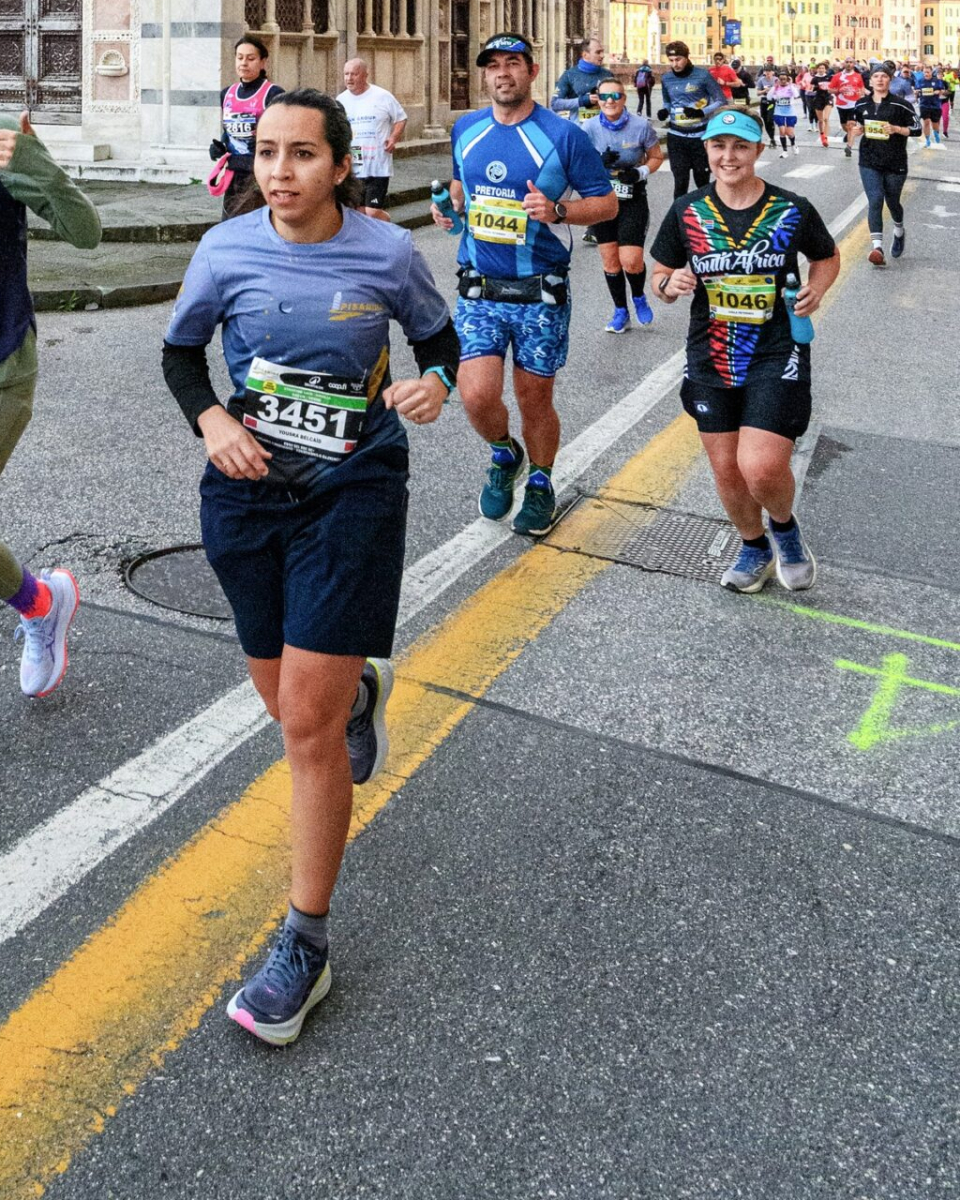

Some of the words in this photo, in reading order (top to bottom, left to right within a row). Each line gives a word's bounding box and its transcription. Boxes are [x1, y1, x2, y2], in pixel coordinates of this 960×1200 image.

[475, 185, 516, 198] PRETORIA
[475, 212, 518, 232] 1044
[692, 251, 732, 274] South
[731, 239, 785, 274] Africa
[715, 291, 768, 310] 1046
[256, 394, 348, 438] 3451
